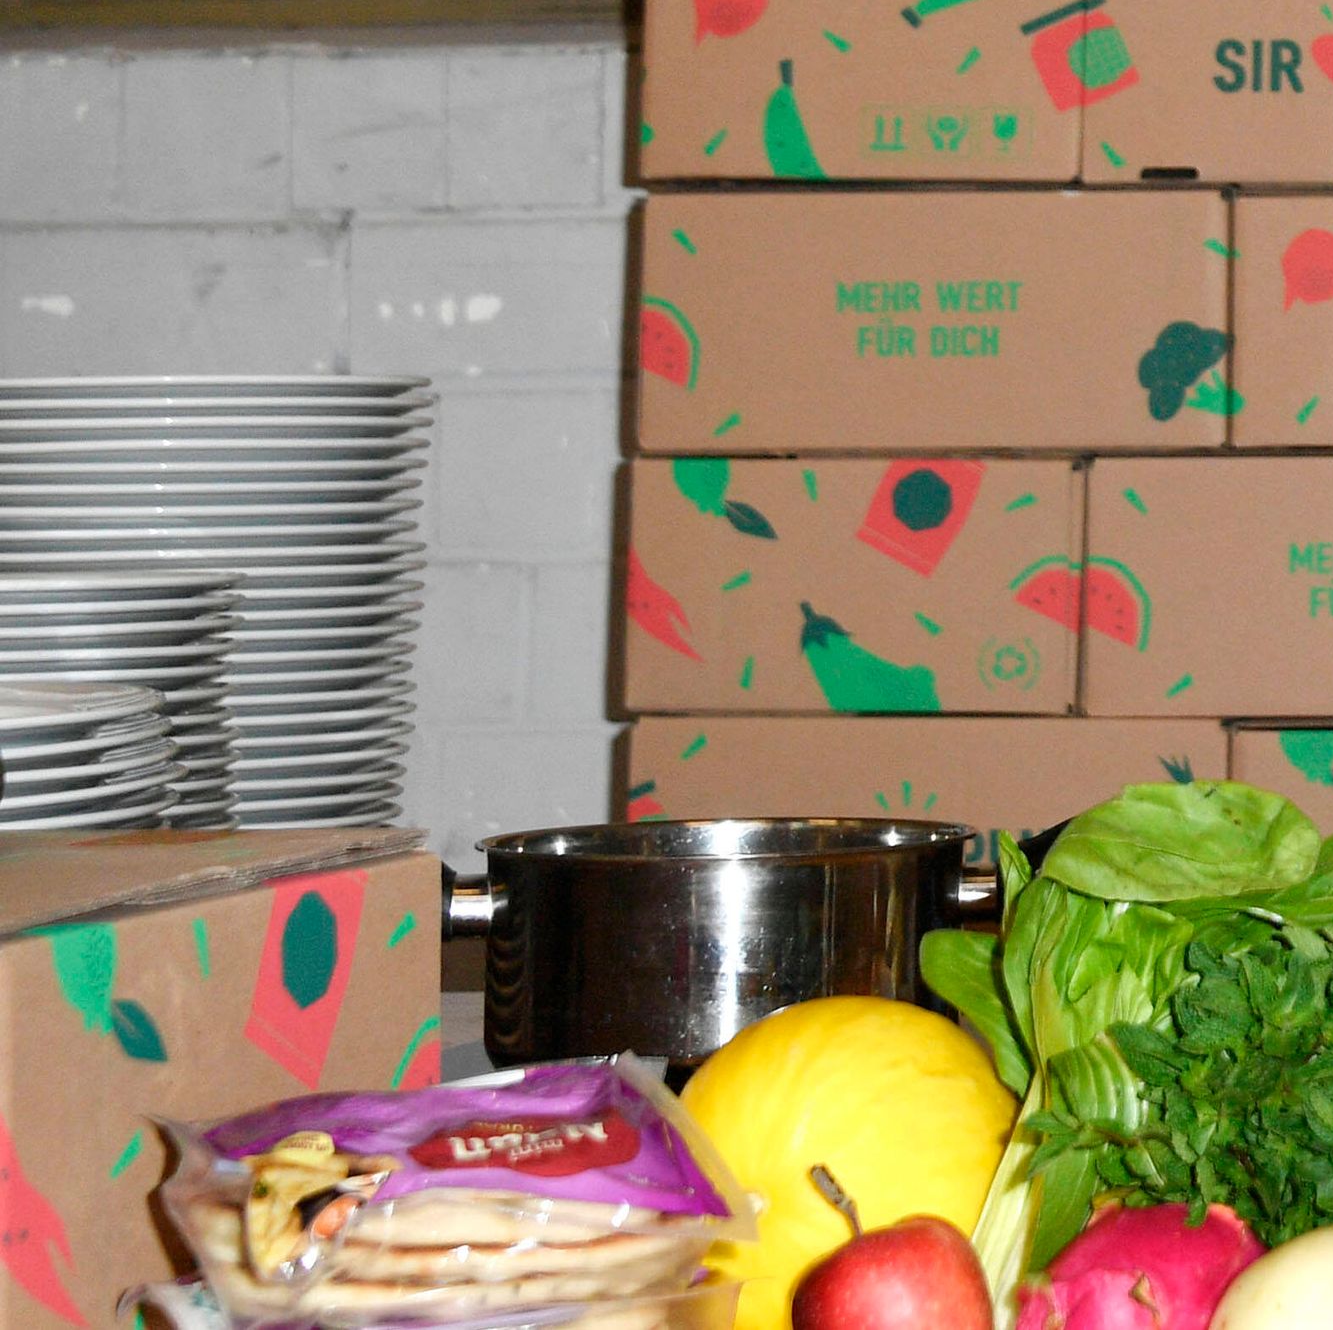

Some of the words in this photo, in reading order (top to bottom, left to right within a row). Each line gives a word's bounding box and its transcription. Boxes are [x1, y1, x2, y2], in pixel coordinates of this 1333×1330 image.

[1214, 38, 1304, 94] SIR
[836, 281, 922, 314] MEHR
[935, 280, 1022, 313] WERT
[857, 317, 916, 357] FÜR
[929, 325, 1000, 358] DICH
